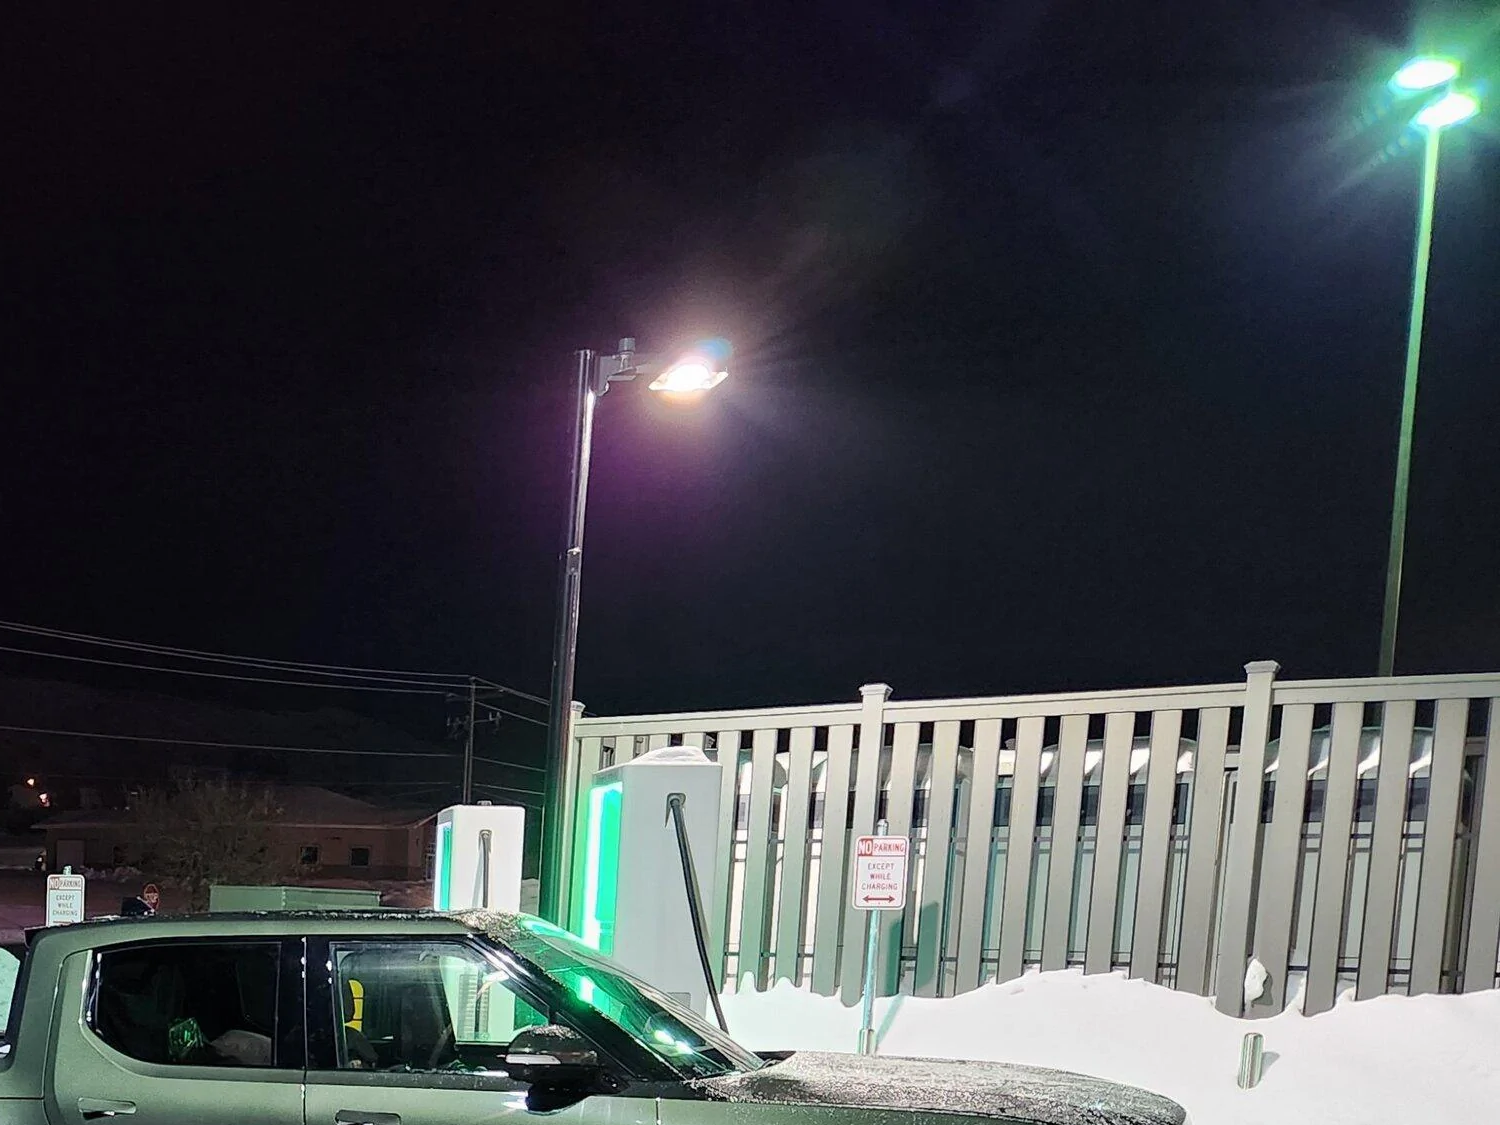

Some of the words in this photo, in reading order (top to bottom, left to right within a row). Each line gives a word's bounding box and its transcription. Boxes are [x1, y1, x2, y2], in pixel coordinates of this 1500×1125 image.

[858, 839, 873, 855] NO
[874, 842, 905, 853] PARKING
[867, 862, 895, 870] EXCEPT
[861, 882, 898, 891] CHARGING
